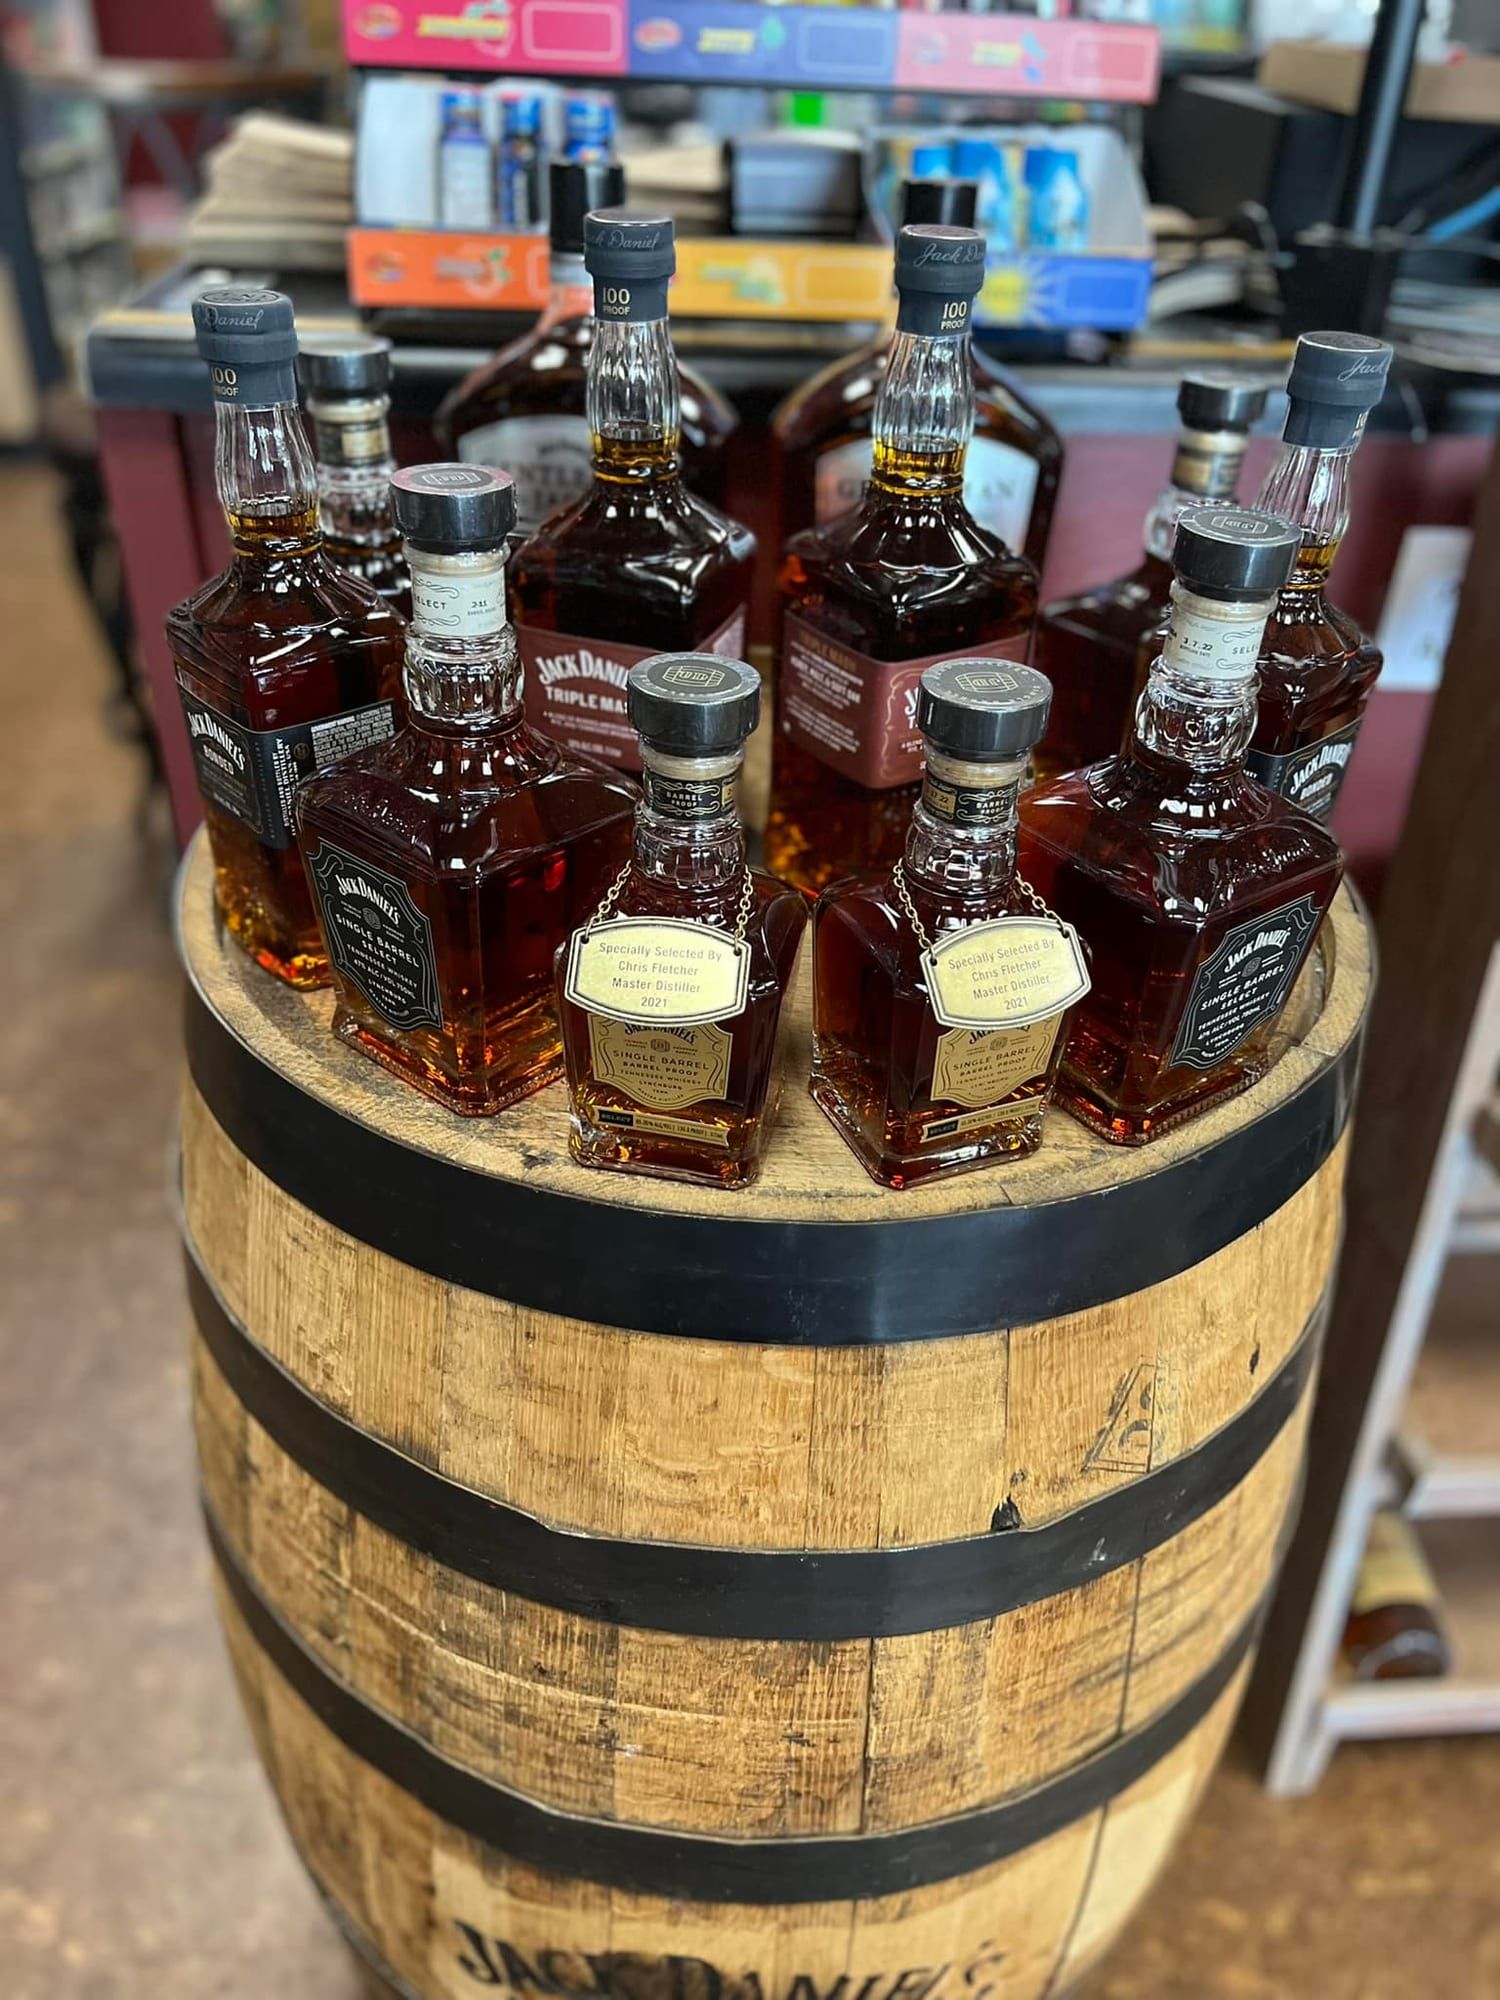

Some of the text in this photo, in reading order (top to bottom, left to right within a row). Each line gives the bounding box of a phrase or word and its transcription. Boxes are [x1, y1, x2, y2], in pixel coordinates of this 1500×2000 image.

[912, 242, 964, 269] Jack
[602, 287, 631, 305] 100
[942, 300, 968, 320] 100
[940, 318, 967, 330] PROOF
[535, 649, 629, 691] JACK DANI
[545, 686, 628, 714] TRIPLE MA
[204, 711, 246, 772] DANIEL'S
[666, 791, 703, 801] BARREL
[335, 874, 401, 925] JACK DANIEL'S
[336, 913, 420, 968] SINGLE BARREL
[361, 940, 397, 965] SELECT
[599, 942, 722, 962] Specially Selected By
[947, 938, 1055, 971] Specially Selected By
[1224, 940, 1255, 973] JACK
[618, 960, 699, 976] Chris Fletcher
[971, 959, 1042, 983] Chris Fletcher
[611, 977, 701, 993] Master Distiller
[973, 975, 1051, 1001] Master Distiller
[1200, 964, 1285, 1011] SINGLE BARREL
[640, 996, 668, 1008] 2021
[1003, 996, 1028, 1011] 2021
[1220, 986, 1259, 1011] SELECT
[612, 1050, 710, 1070] SINGLE BARREL
[623, 1061, 699, 1077] BARREL PROOF
[953, 1045, 1037, 1071] SINGLE BARREL
